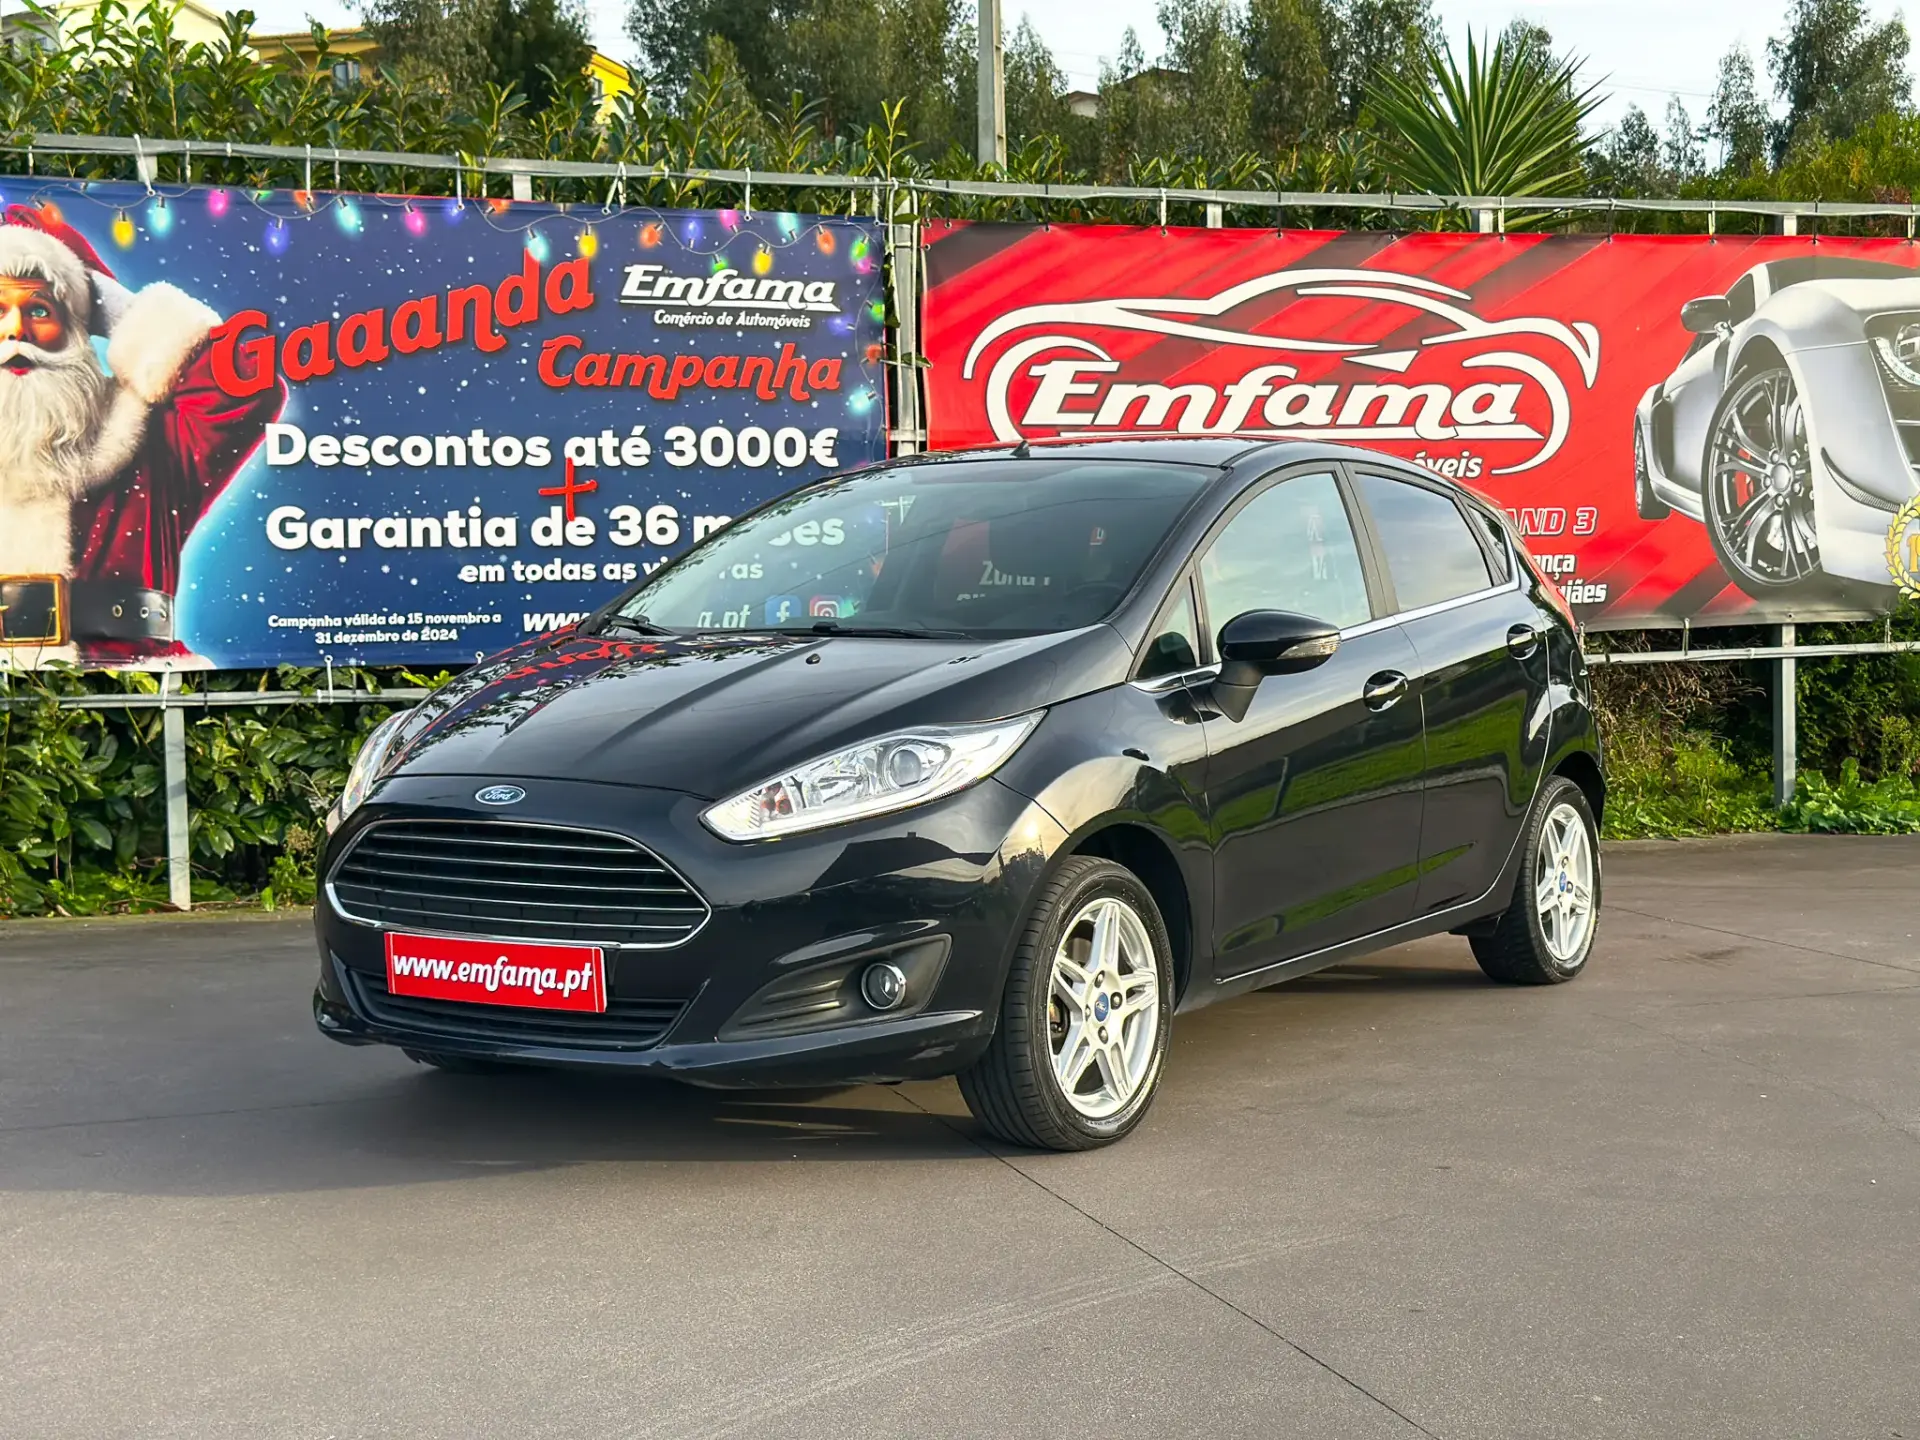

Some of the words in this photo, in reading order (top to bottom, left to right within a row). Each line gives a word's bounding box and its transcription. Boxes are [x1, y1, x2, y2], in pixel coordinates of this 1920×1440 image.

[622, 264, 836, 309] Emfama
[210, 247, 594, 398] Gaaanda
[654, 309, 714, 327] Comércio
[716, 312, 733, 326] de
[736, 310, 811, 330] Automóveis
[537, 335, 842, 401] Campanha
[1021, 360, 1524, 440] Emfama
[265, 423, 552, 467] Descontos
[563, 425, 651, 467] até
[663, 425, 840, 468] 3000€
[265, 505, 517, 550] Garantia
[530, 505, 596, 547] de
[608, 504, 680, 546] 36
[1572, 506, 1597, 534] 3
[460, 564, 505, 582] em
[511, 558, 597, 582] todas
[603, 563, 637, 581] as
[268, 614, 342, 629] Campanha
[344, 613, 386, 626] válida
[388, 614, 405, 625] de
[407, 612, 423, 624] 15
[425, 612, 489, 625] novembro
[492, 614, 502, 623] a
[315, 632, 331, 644] 31
[333, 631, 399, 643] dezembro
[401, 629, 418, 641] de
[420, 628, 458, 641] 2024
[484, 788, 516, 800] Ford
[393, 954, 592, 997] www.emfama.pt
